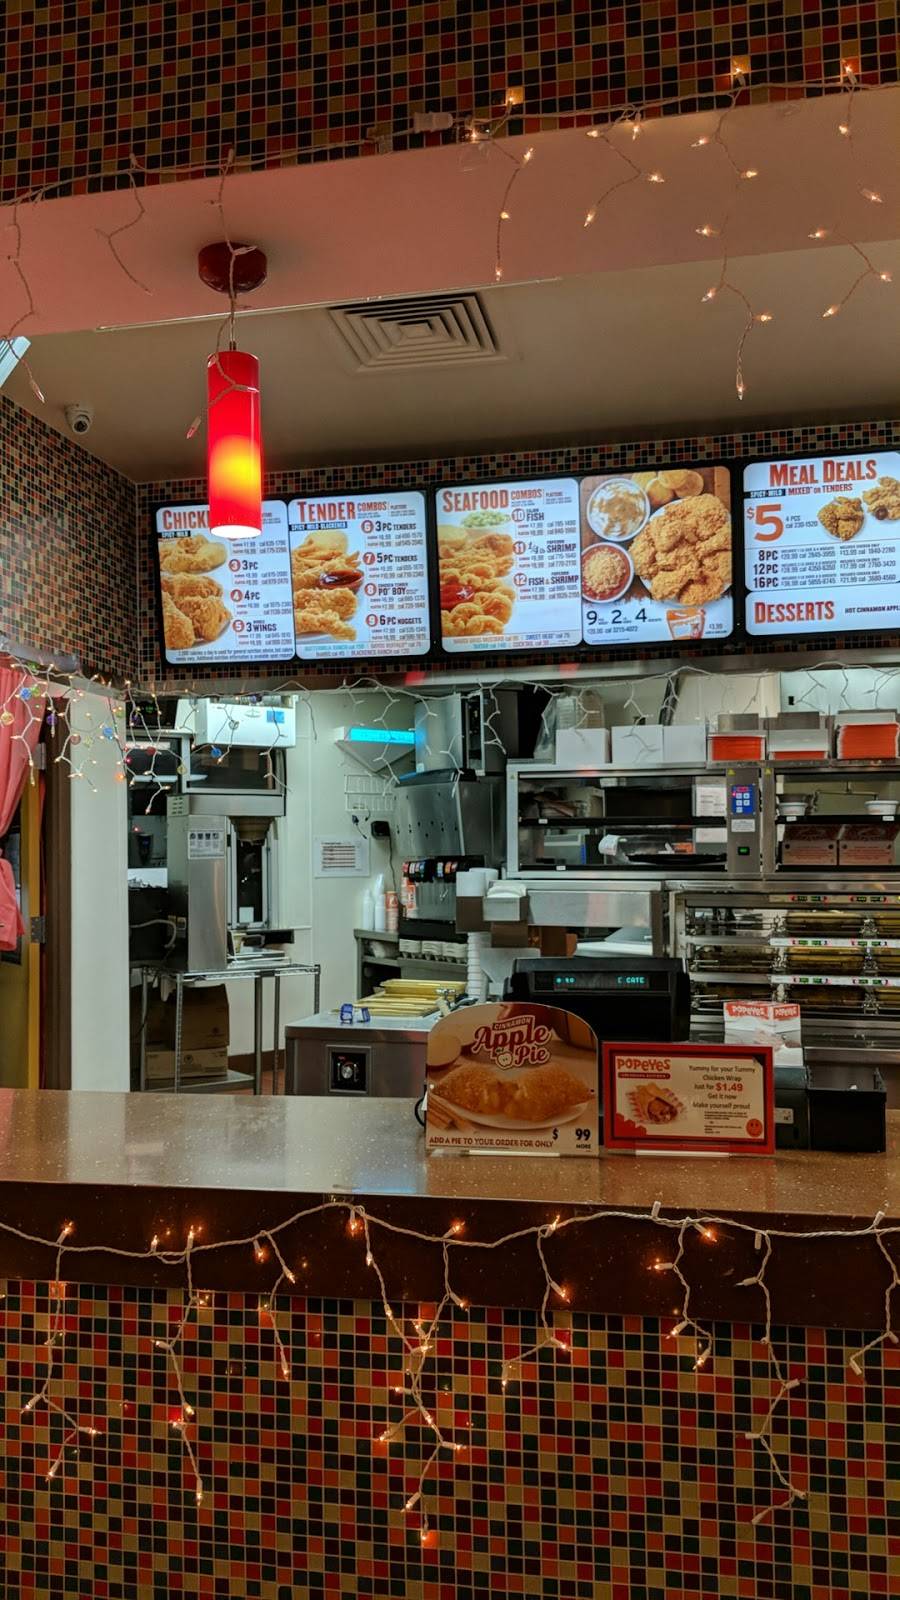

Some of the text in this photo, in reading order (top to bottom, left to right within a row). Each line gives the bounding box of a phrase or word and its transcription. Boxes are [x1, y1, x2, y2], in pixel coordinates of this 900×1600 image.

[769, 460, 877, 487] MEAL DEALS
[822, 484, 853, 493] TENDERS
[443, 489, 509, 513] SEAFOOD
[511, 489, 542, 500] COMBOS
[297, 501, 356, 522] TENDER
[357, 502, 387, 511] COMBOS
[527, 513, 545, 521] FISH
[163, 510, 210, 530] CHICK
[547, 544, 576, 553] SHRIMP
[758, 550, 778, 561] 8PC
[753, 564, 778, 575] 12PC
[529, 578, 545, 586] FISH
[551, 575, 579, 584] SHRIMP
[753, 577, 778, 589] 16PC
[392, 587, 406, 595] BOY
[586, 608, 647, 625] 9 2 4
[754, 601, 835, 624] DESSERTS
[253, 624, 277, 632] WINGS
[473, 1023, 548, 1058] Apple
[515, 1046, 548, 1065] Pie
[715, 1082, 743, 1092] $1.49
[575, 1129, 591, 1141] 99
